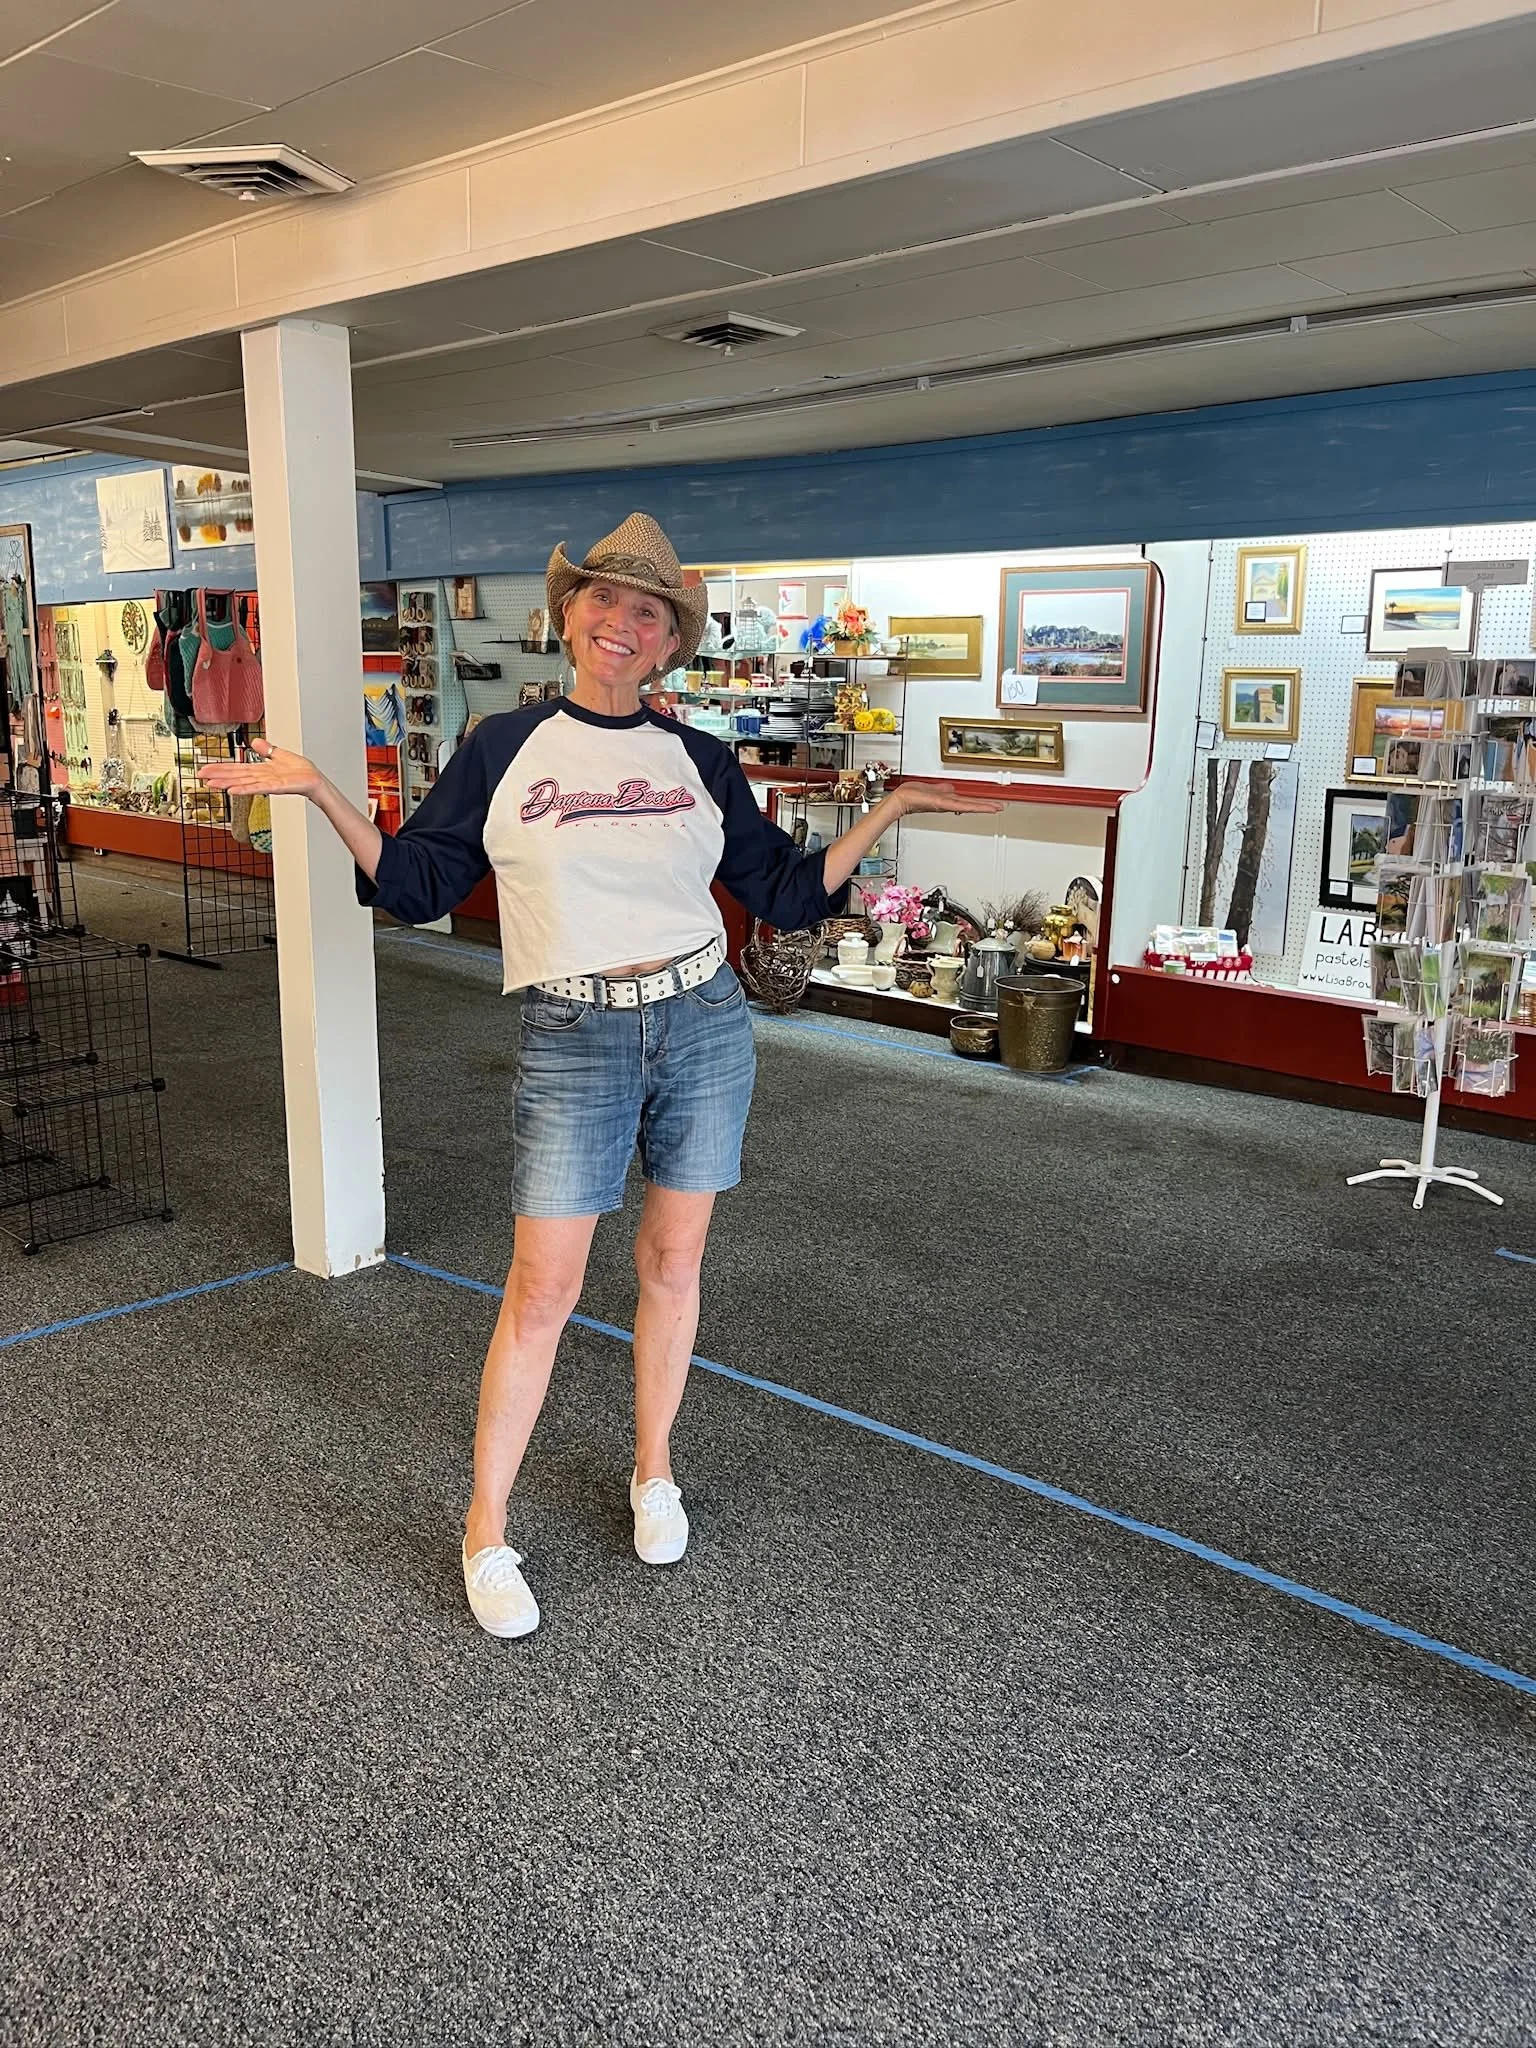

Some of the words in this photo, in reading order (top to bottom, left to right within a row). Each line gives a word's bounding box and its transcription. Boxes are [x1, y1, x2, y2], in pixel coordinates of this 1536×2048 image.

[521, 777, 614, 825] Daytona
[613, 777, 695, 811] Beach
[1315, 951, 1371, 970] pastels
